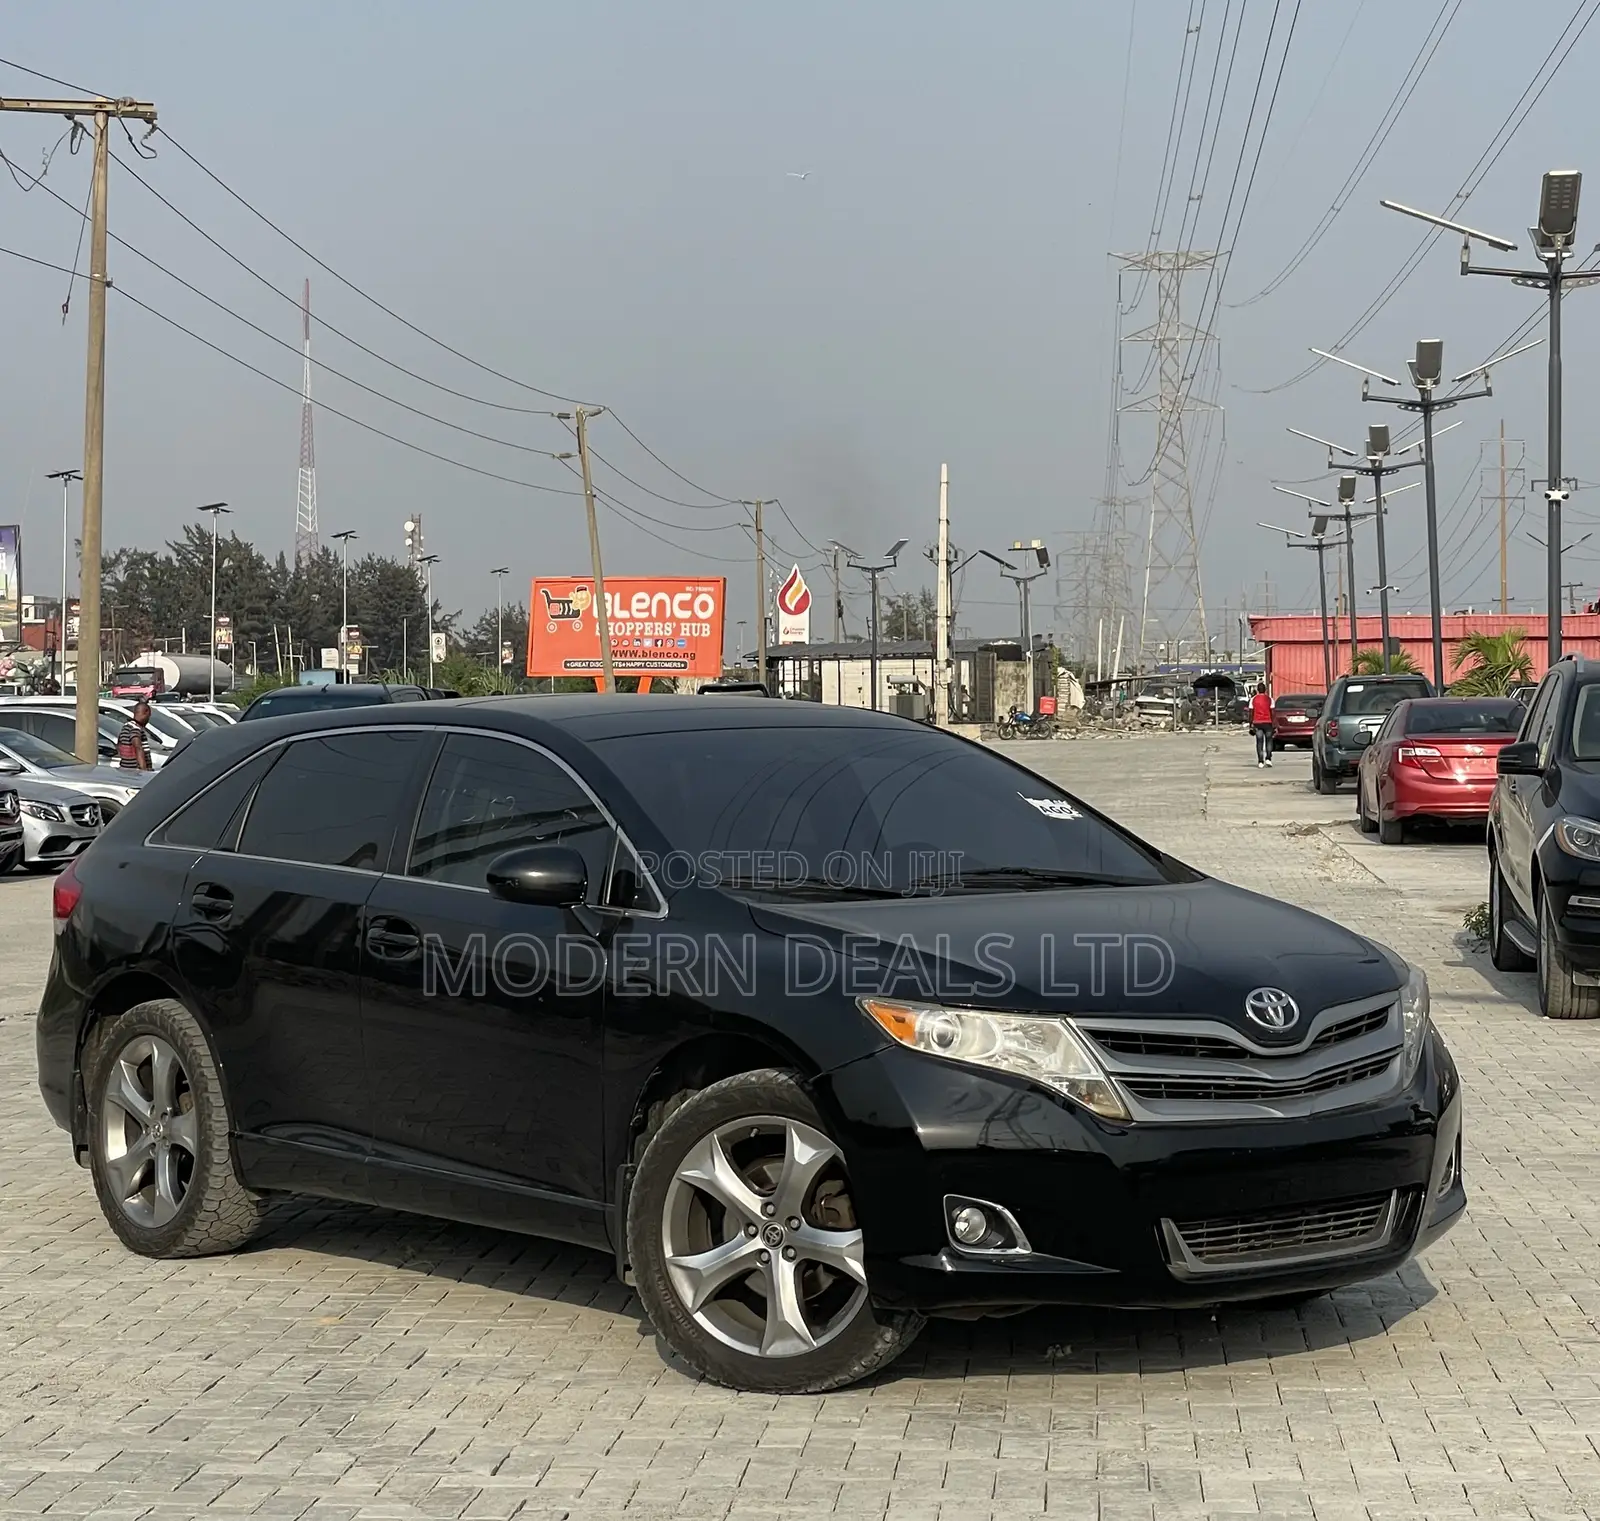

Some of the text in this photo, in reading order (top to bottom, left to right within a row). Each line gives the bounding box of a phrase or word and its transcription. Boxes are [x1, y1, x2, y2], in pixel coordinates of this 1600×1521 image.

[680, 623, 711, 637] HUB
[590, 660, 622, 668] DISCTS
[626, 660, 645, 668] HAPPY
[646, 660, 681, 668] CUSTOMERS
